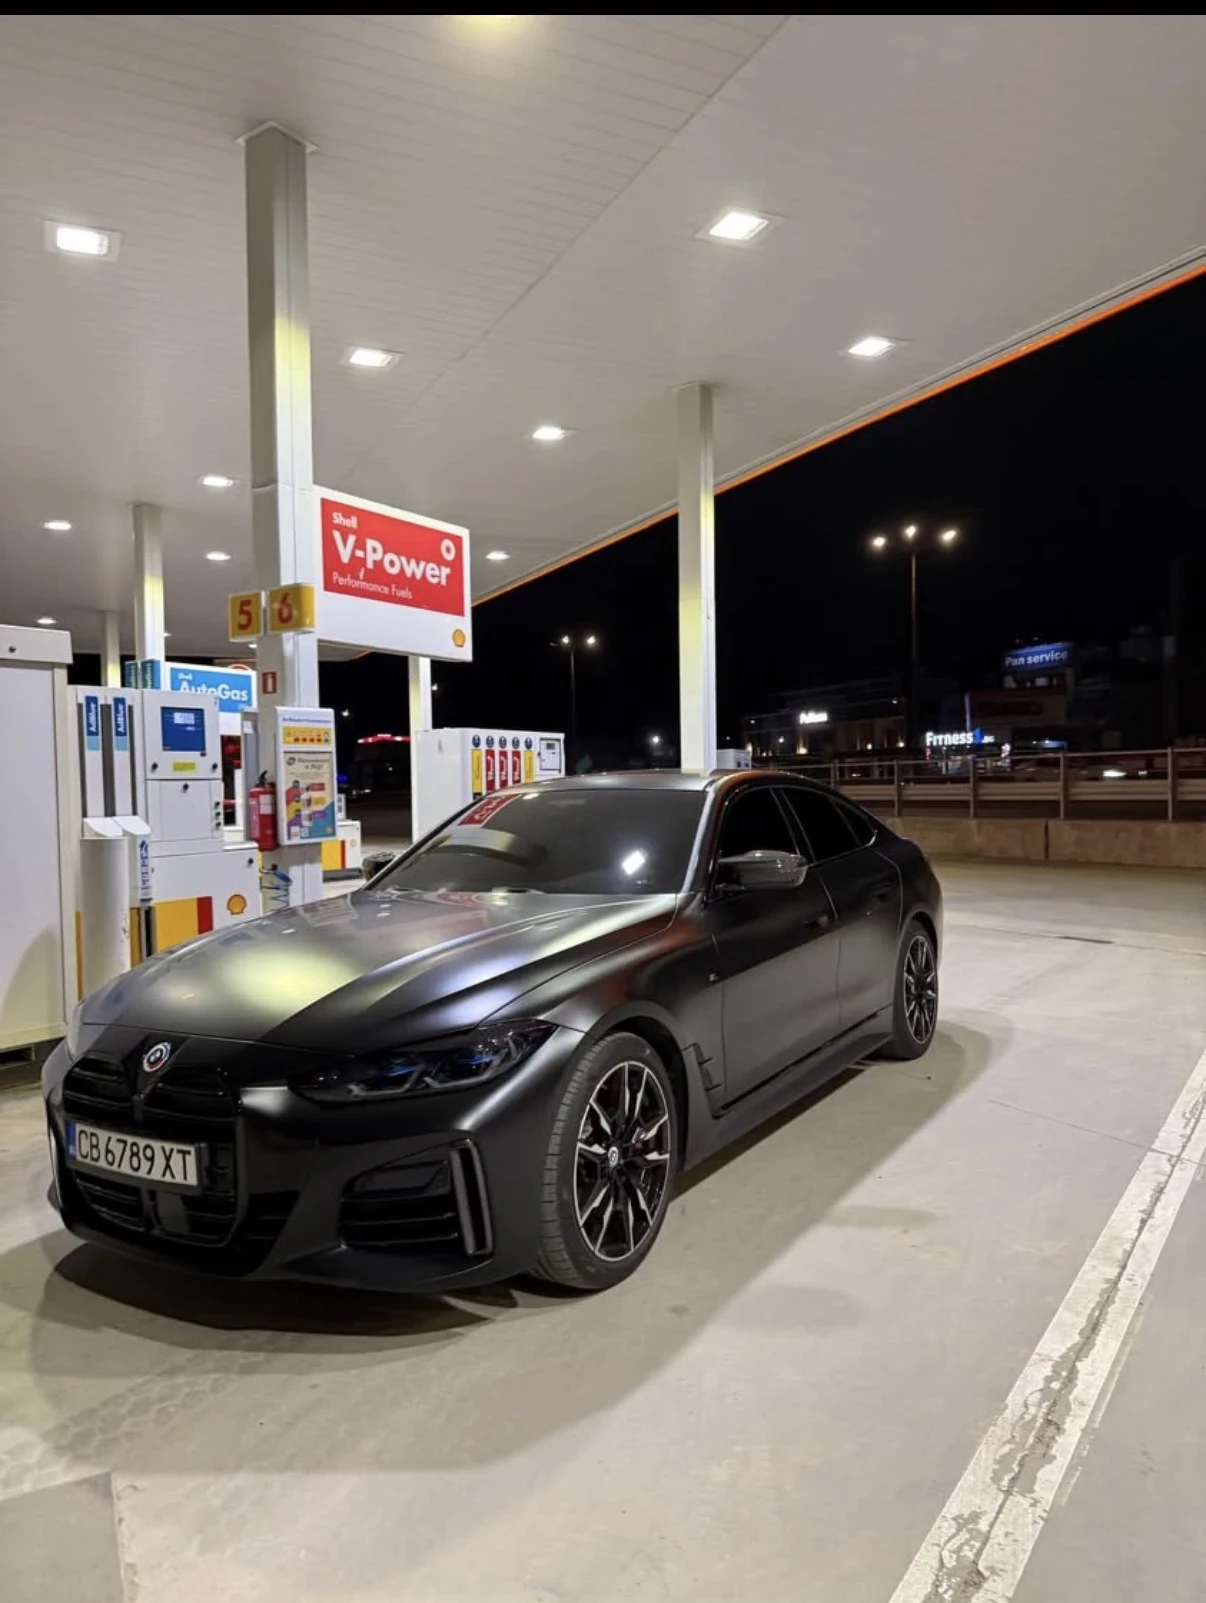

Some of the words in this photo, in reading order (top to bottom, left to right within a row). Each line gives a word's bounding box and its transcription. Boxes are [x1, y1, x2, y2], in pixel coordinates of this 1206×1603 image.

[332, 511, 358, 530] Shell
[332, 529, 451, 586] V-Power
[332, 571, 390, 595] Performance
[391, 584, 413, 600] Fuels
[237, 598, 253, 632] 5
[277, 591, 294, 625] 6
[1005, 656, 1025, 667] Pan
[1027, 649, 1068, 664] service
[78, 1129, 101, 1163] CB
[104, 1136, 156, 1176] 6789
[160, 1144, 192, 1181] XT
